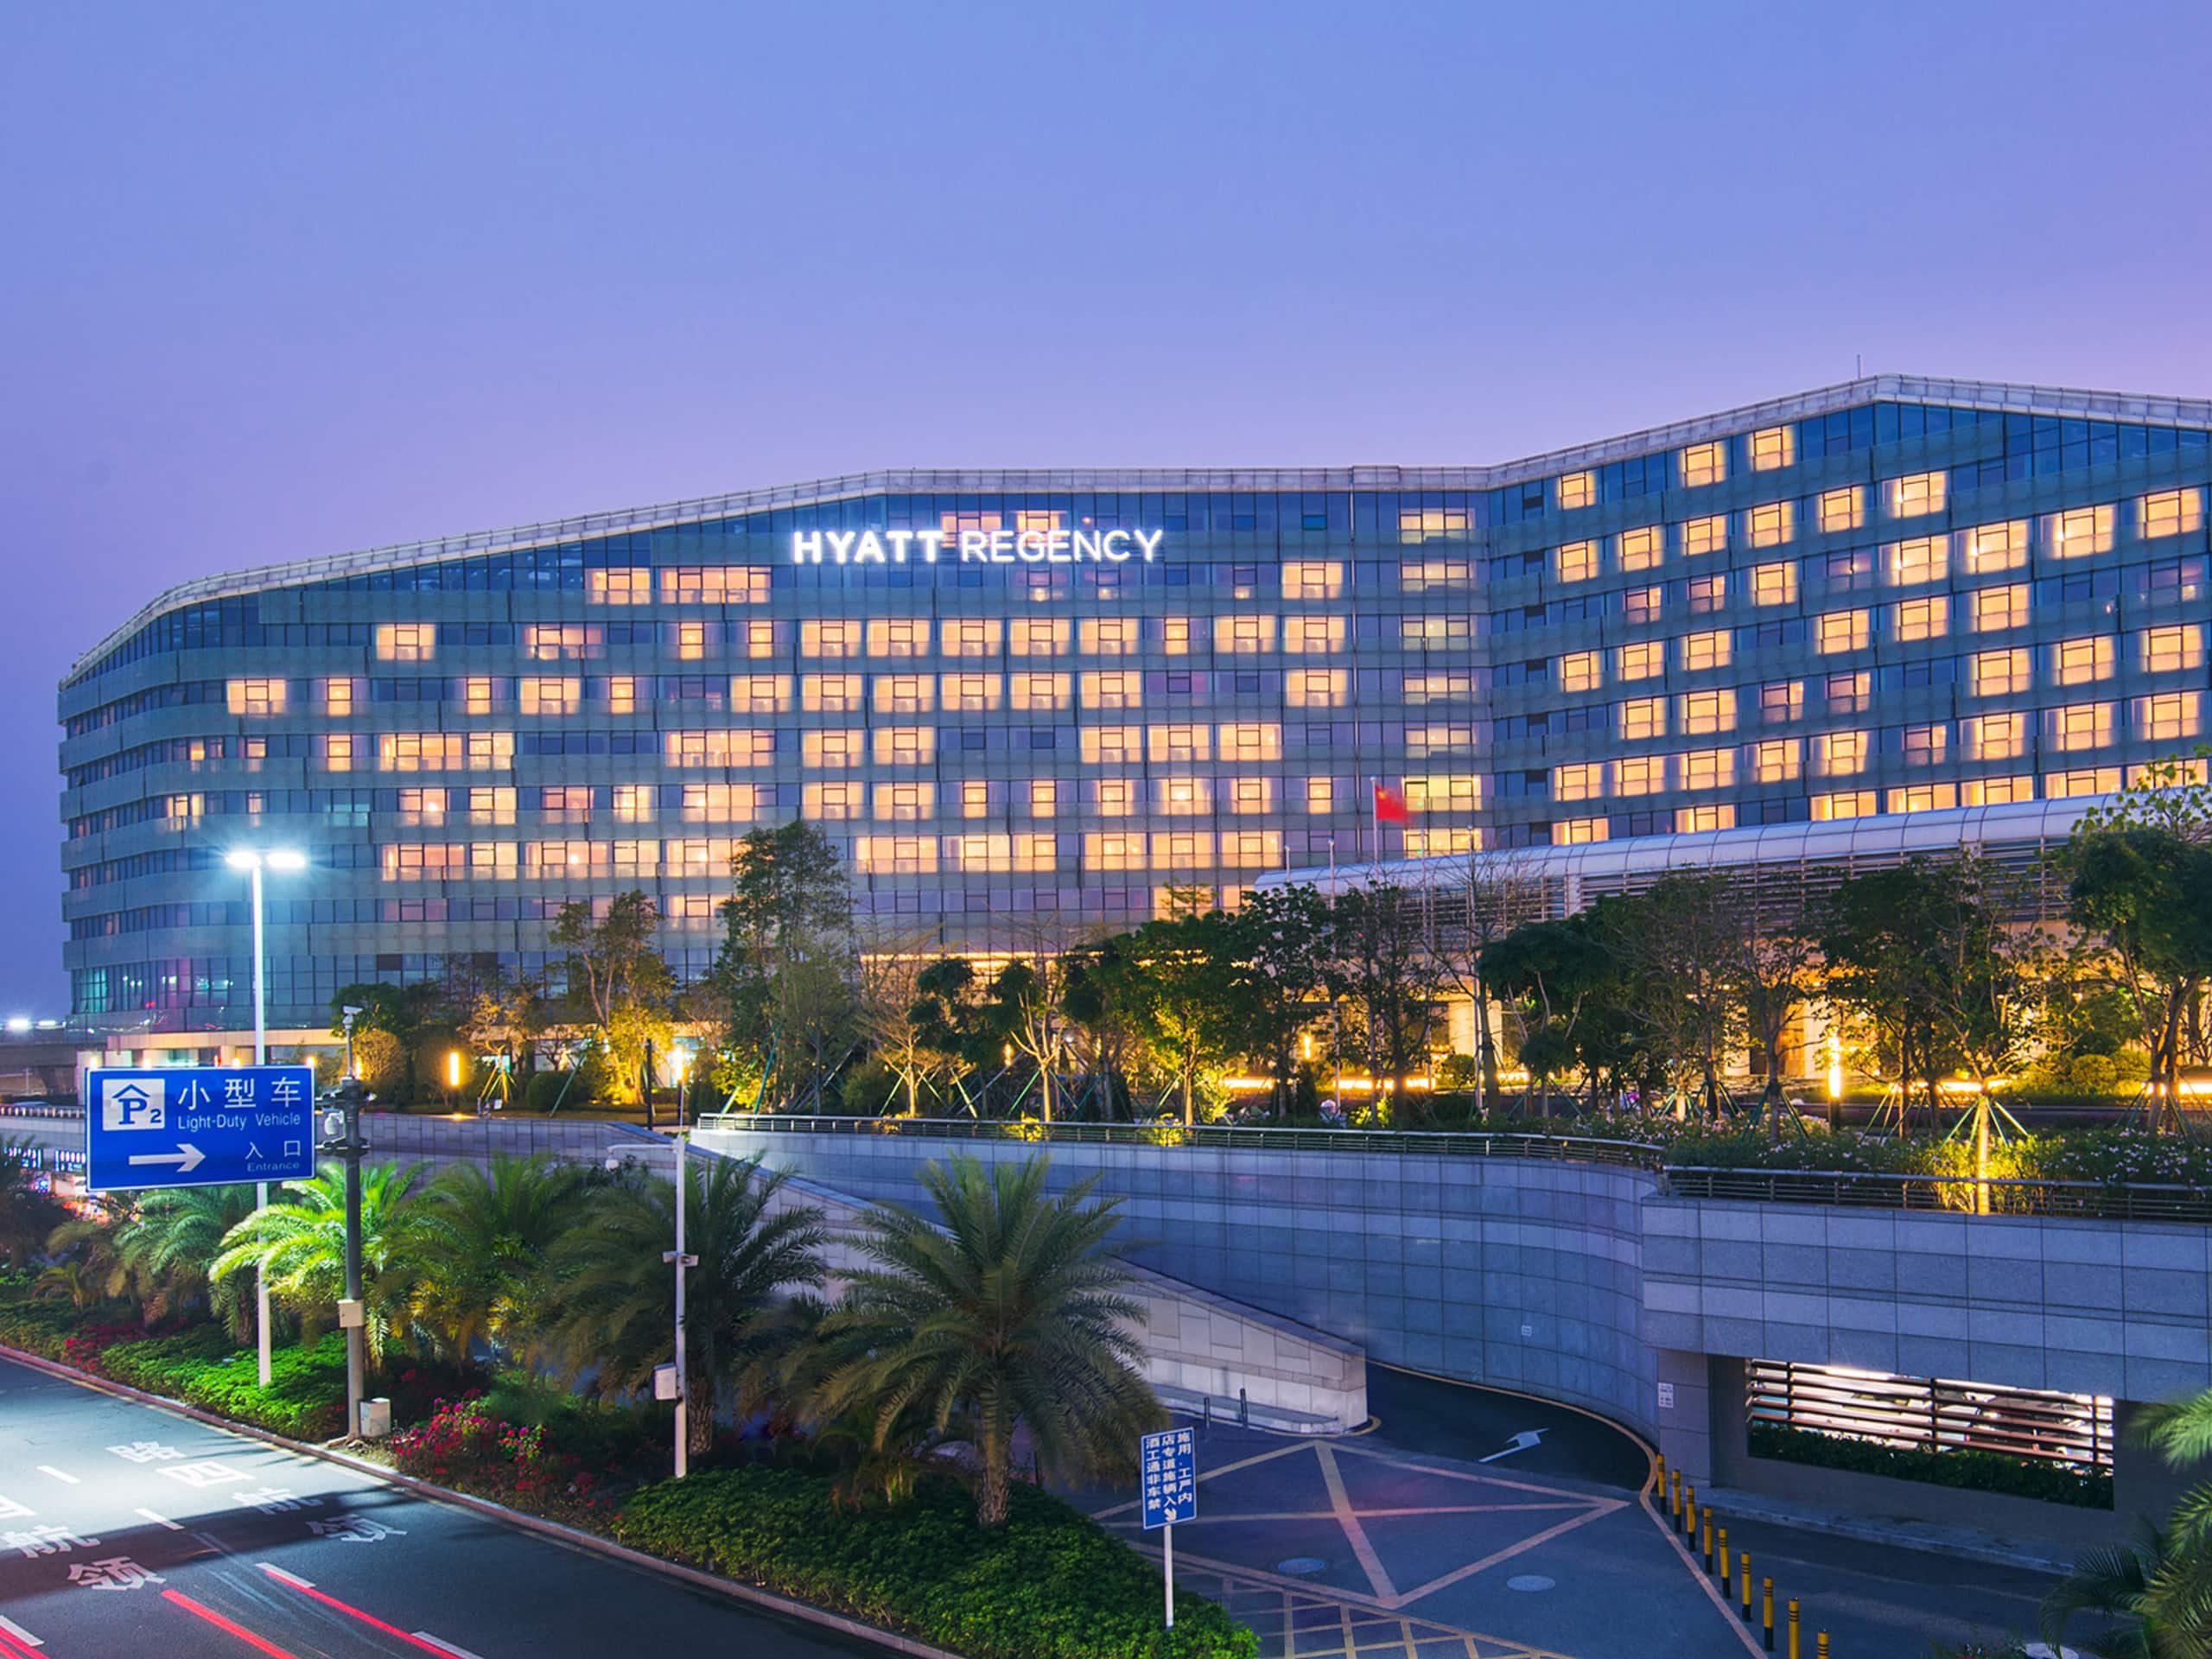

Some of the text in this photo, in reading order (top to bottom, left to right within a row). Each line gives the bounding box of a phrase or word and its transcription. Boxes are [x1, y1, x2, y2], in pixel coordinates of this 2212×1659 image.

[791, 529, 1164, 563] HYATT REGENCY
[177, 1077, 302, 1111] 小型车
[255, 1112, 302, 1128] Vehicle
[245, 1140, 302, 1160] 入口
[247, 1161, 300, 1173] Entrance
